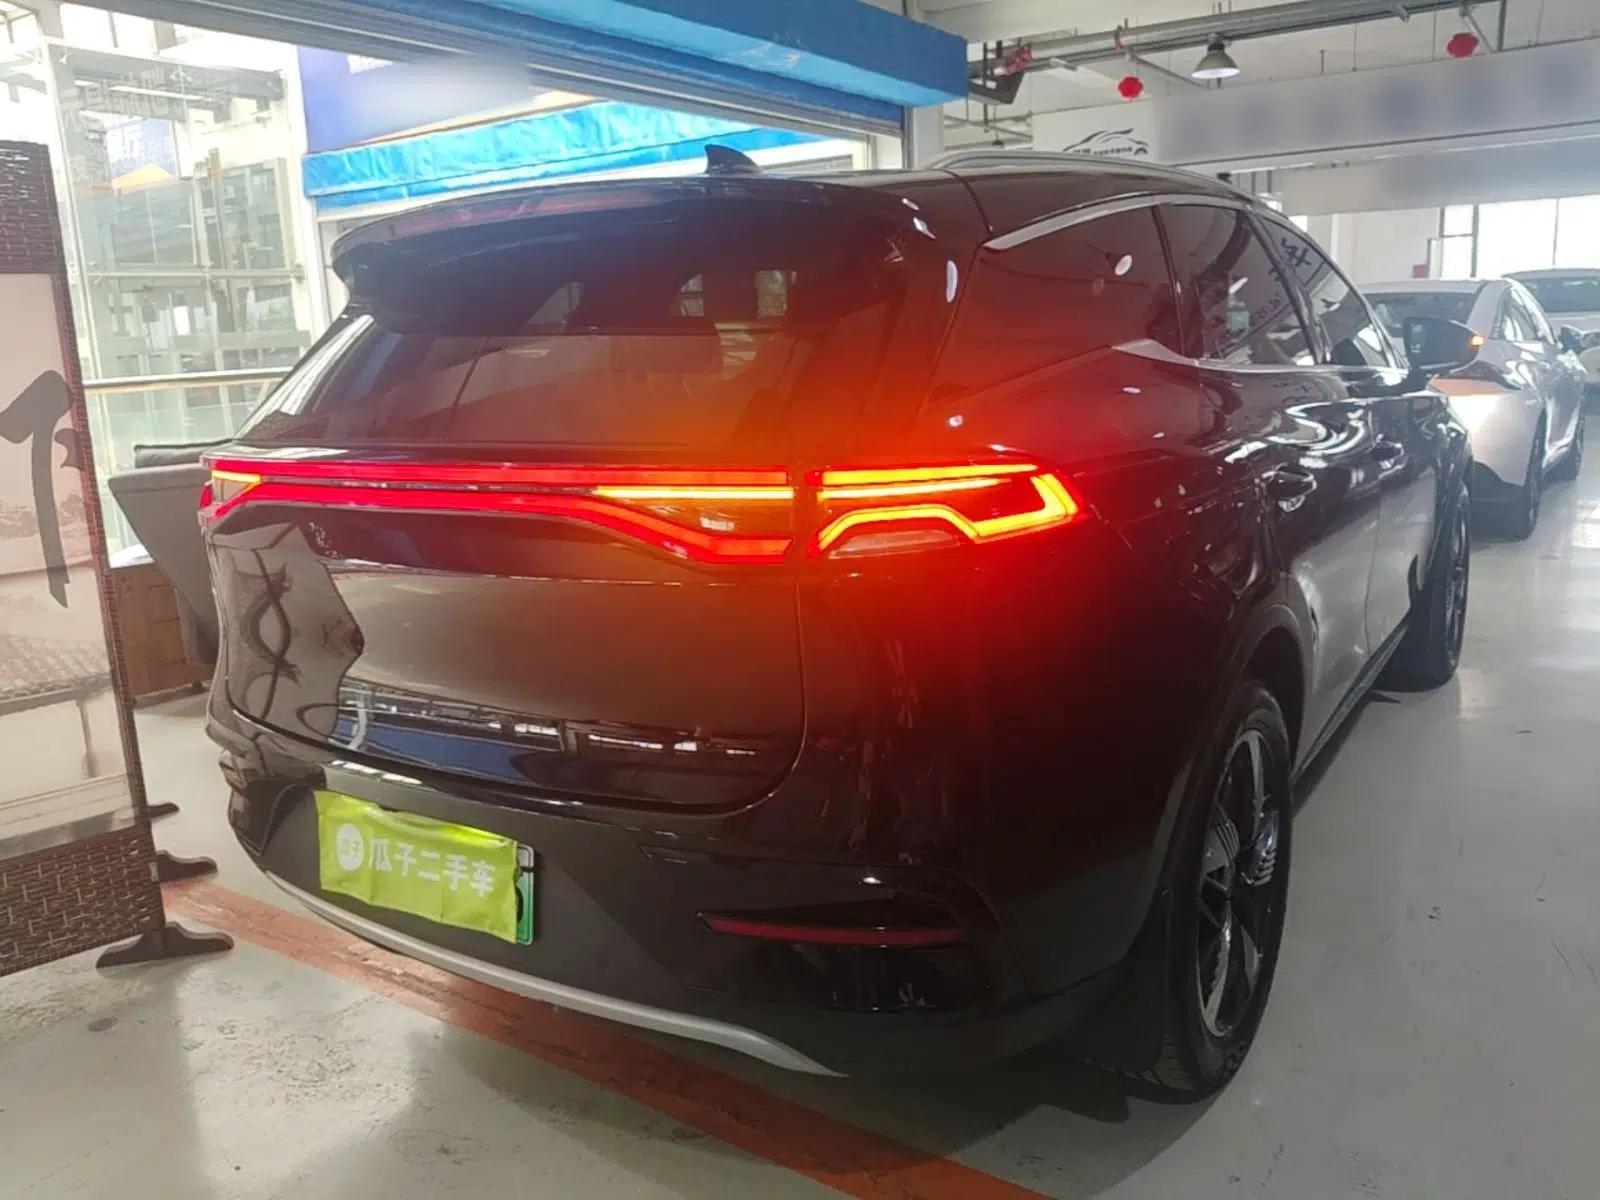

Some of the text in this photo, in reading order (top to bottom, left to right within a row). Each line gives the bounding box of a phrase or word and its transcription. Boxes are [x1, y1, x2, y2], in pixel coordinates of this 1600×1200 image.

[368, 837, 497, 899] 瓜子二手车
